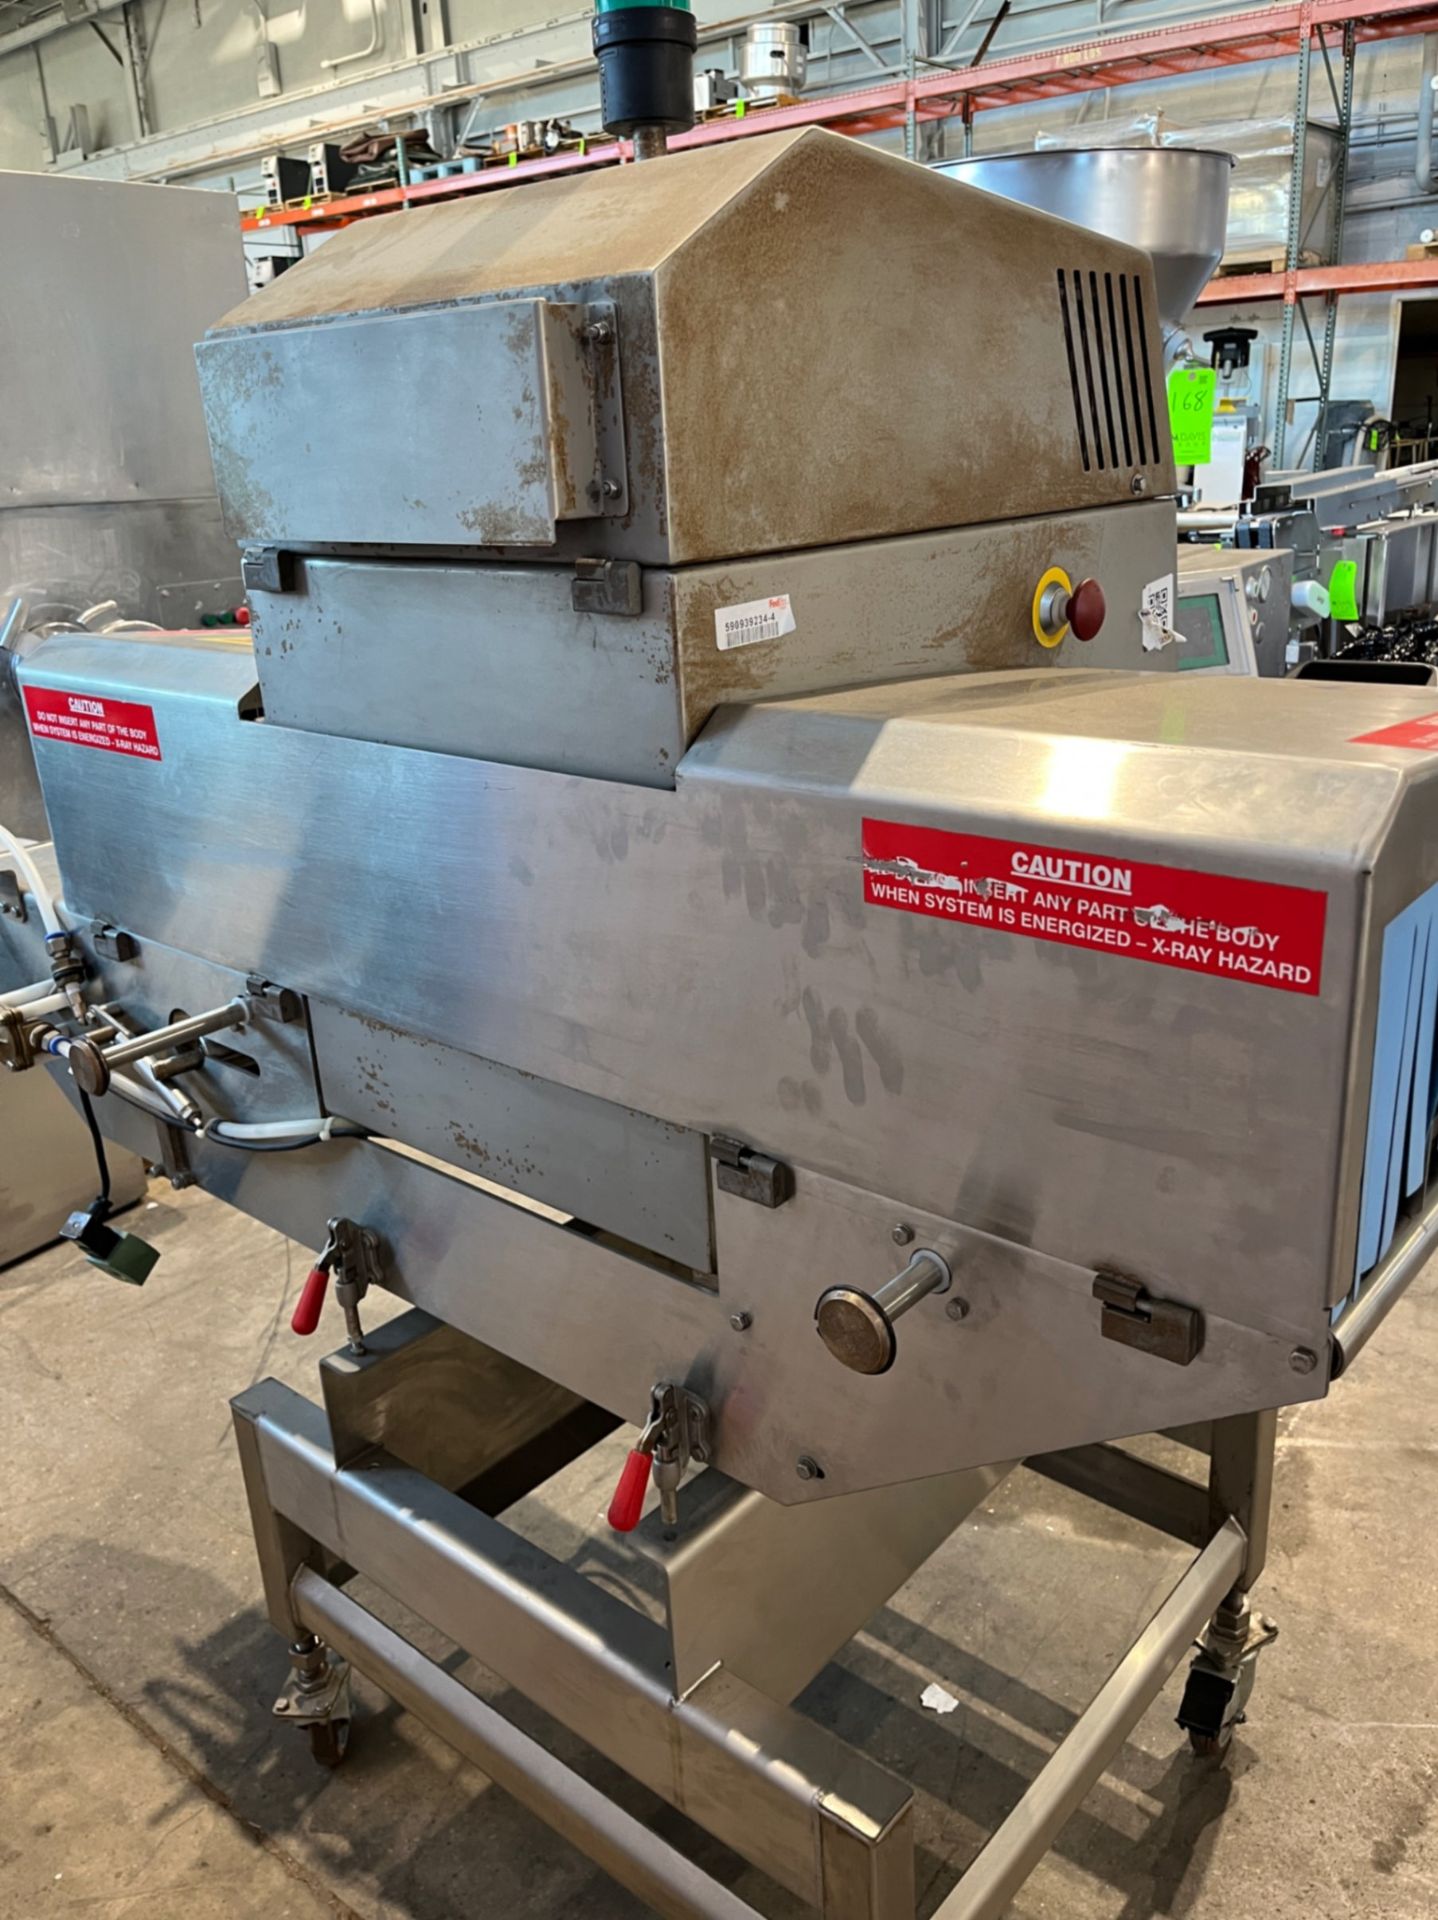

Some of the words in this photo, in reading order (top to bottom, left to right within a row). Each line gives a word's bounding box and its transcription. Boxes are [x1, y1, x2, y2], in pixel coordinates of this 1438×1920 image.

[68, 697, 105, 717] CAUTION
[1011, 851, 1132, 893] CAUTION
[1033, 892, 1073, 912] ANY
[1077, 898, 1128, 923] PART
[871, 882, 920, 905] WHEN
[924, 892, 993, 920] SYSTEM
[998, 907, 1016, 924] IS
[1021, 912, 1131, 947] ENERGIZED
[1152, 937, 1212, 964] X-RAY
[1218, 950, 1312, 984] HAZARD
